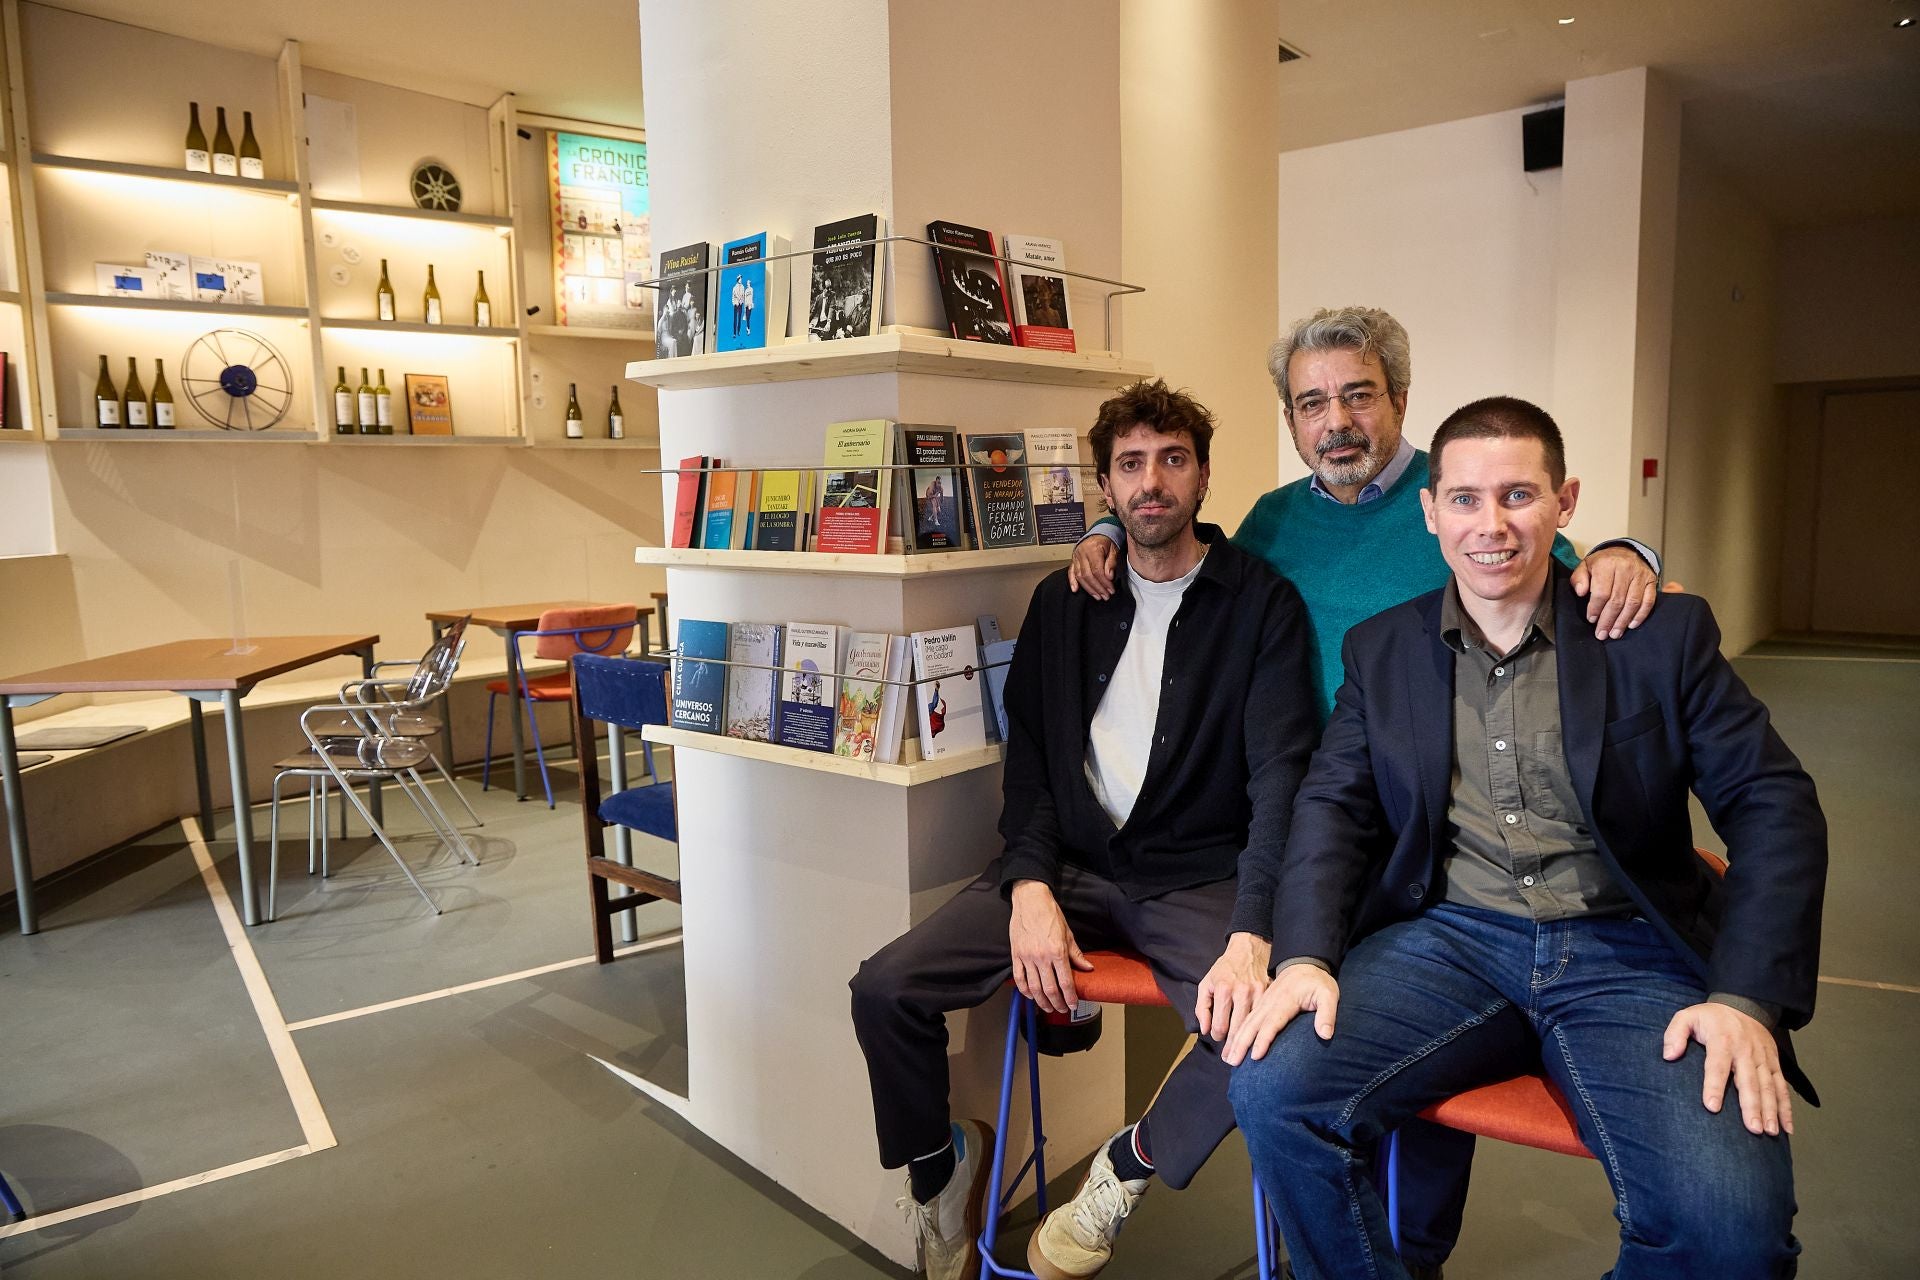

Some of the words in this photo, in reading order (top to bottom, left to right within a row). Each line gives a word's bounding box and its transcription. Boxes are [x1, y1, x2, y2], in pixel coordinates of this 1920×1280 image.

[572, 163, 649, 187] FRANCE
[922, 448, 946, 456] productor
[983, 481, 990, 489] EL
[993, 480, 1022, 488] VENDEDOR
[994, 489, 1025, 499] NARANJAS
[988, 501, 1025, 511] FERNANDO
[990, 523, 1025, 539] GÓMEZ
[924, 636, 941, 645] Pedro
[675, 699, 713, 712] UNIVERSOS
[674, 709, 711, 722] CERCANOS
